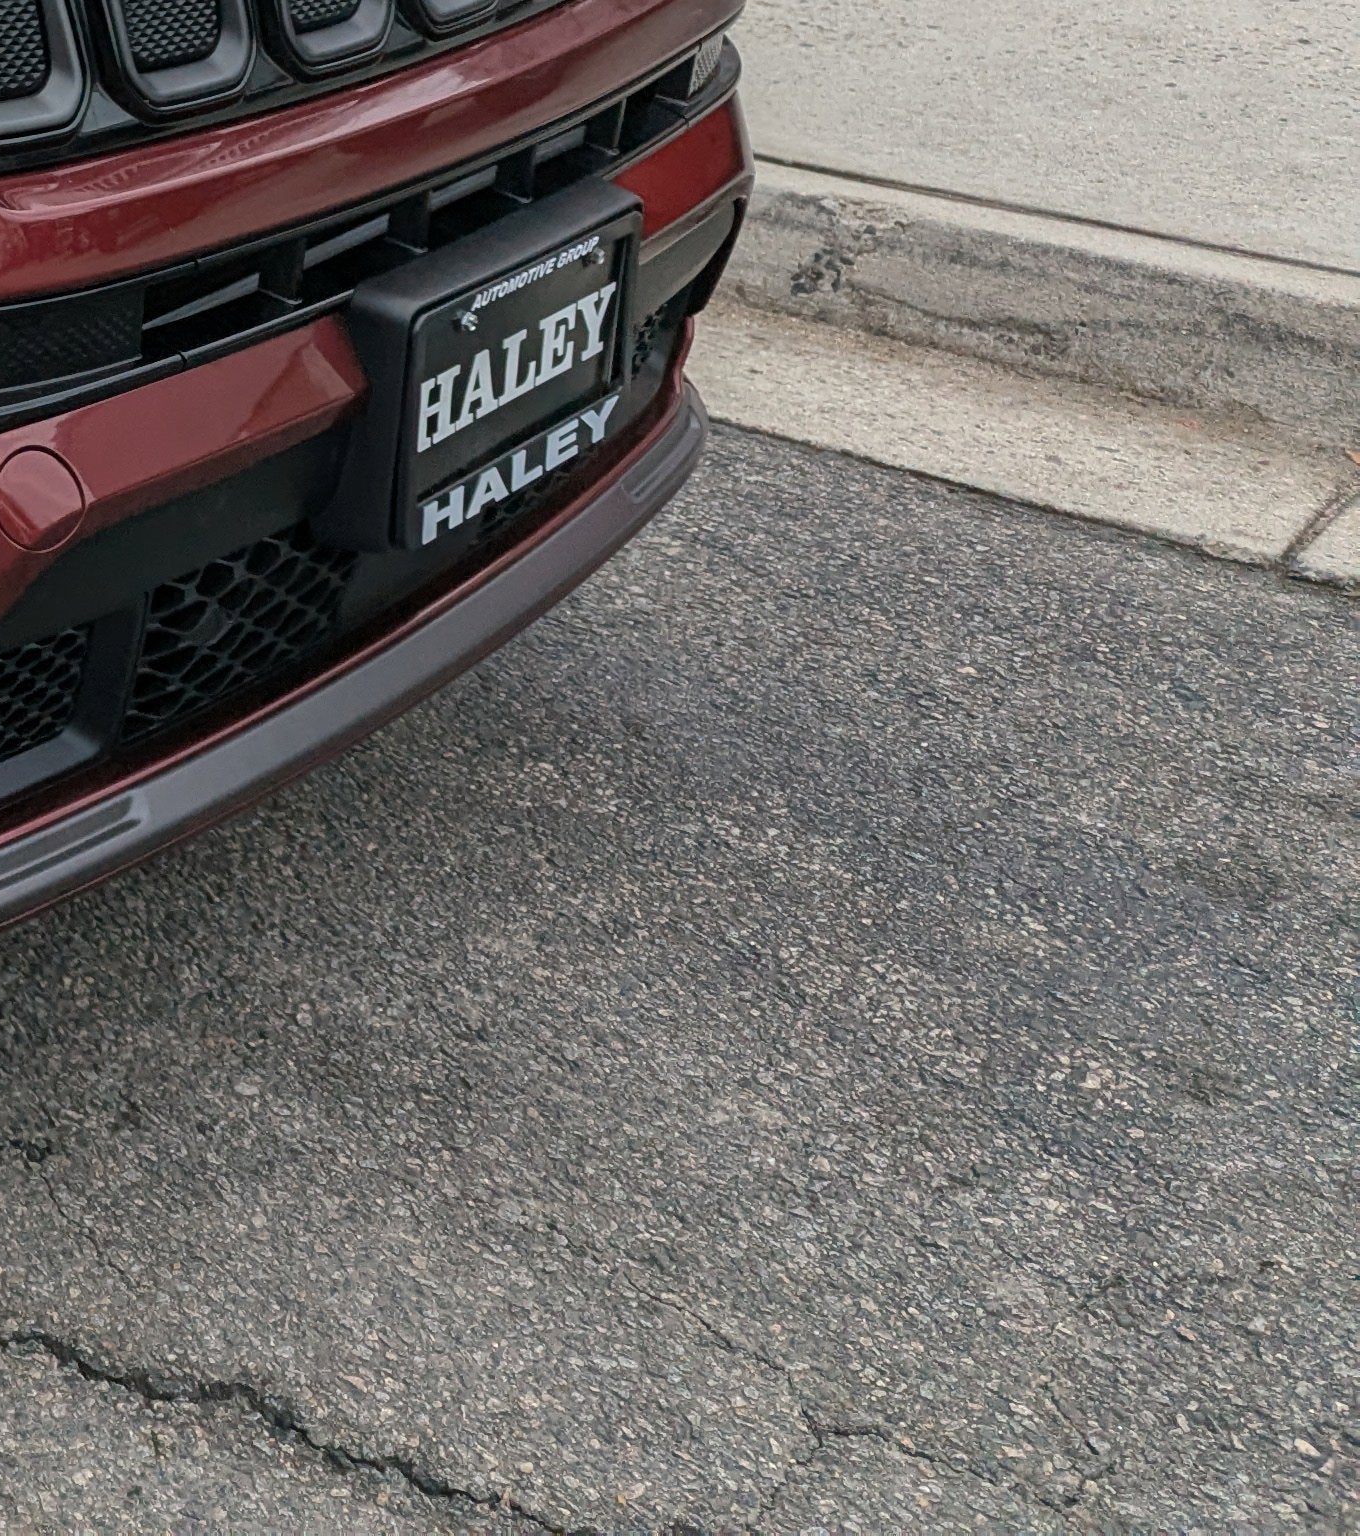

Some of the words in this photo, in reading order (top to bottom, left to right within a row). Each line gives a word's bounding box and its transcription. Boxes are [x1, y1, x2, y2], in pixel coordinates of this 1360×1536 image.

[471, 256, 557, 312] AUTOMOTIVE
[556, 235, 600, 270] GROUP
[416, 281, 617, 454] HALEY
[421, 394, 620, 546] HALEY
